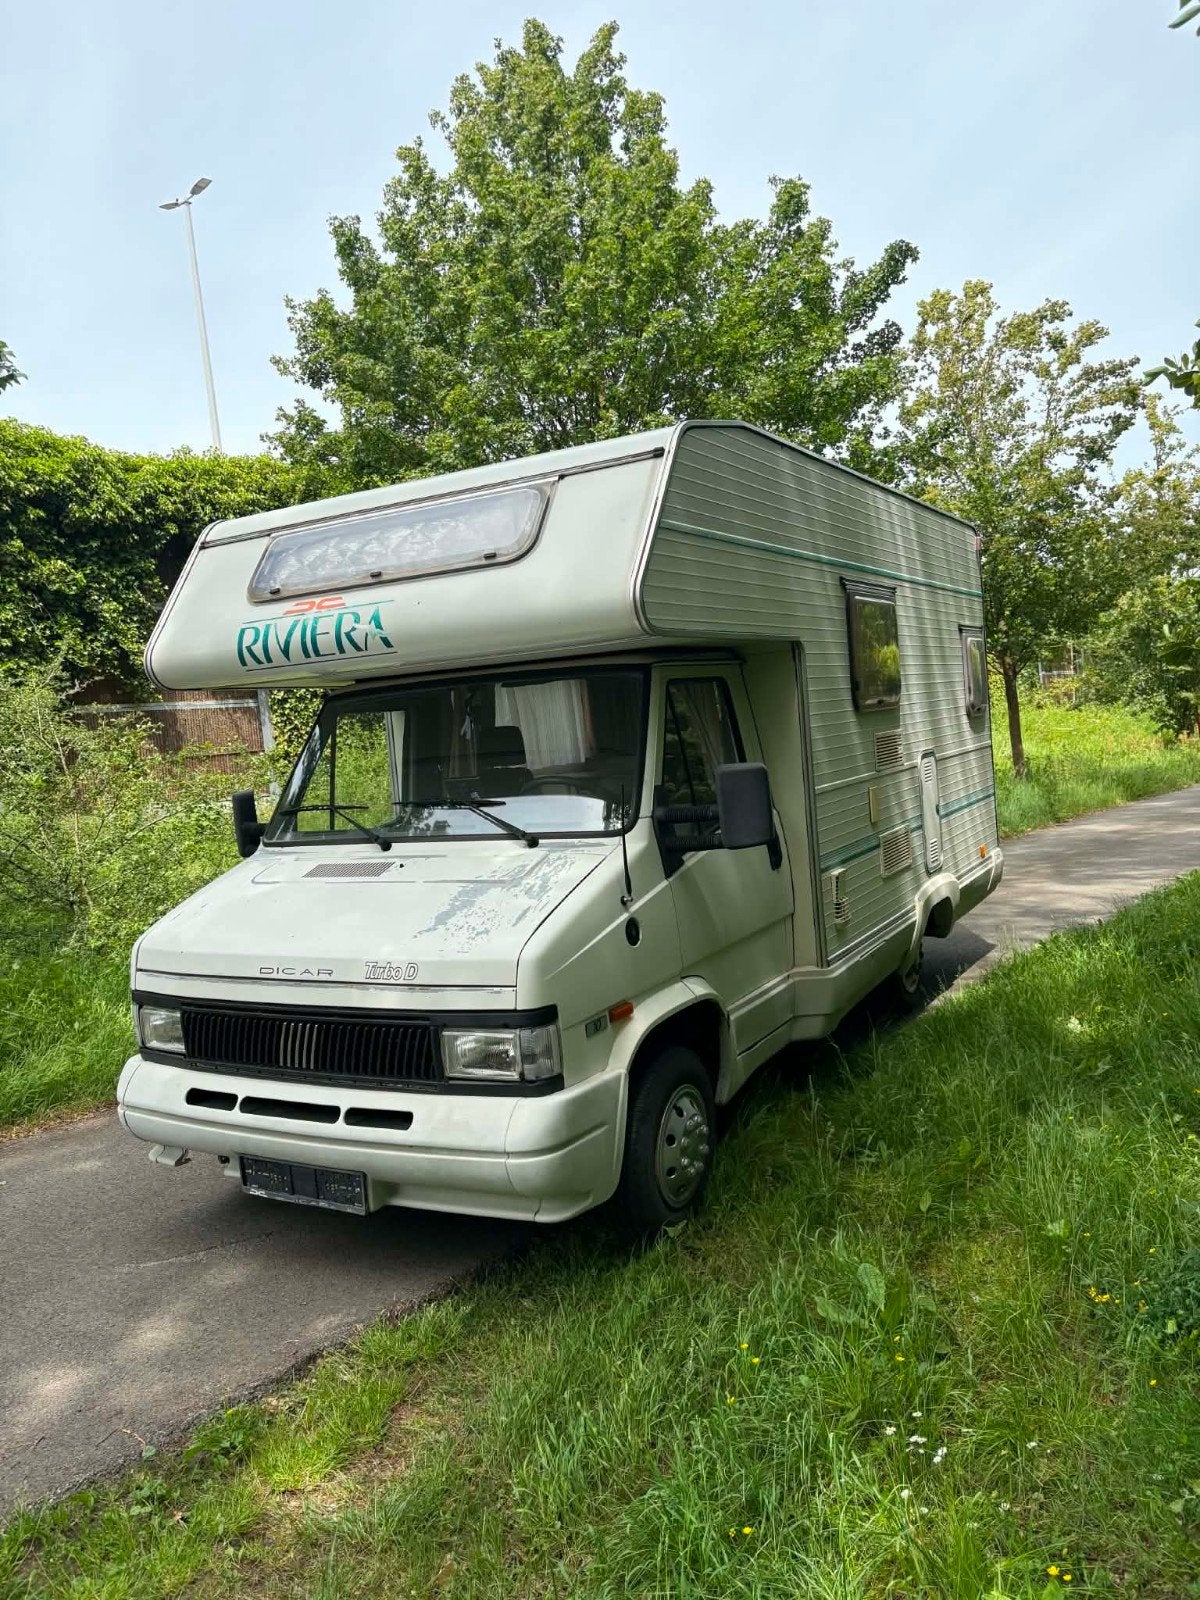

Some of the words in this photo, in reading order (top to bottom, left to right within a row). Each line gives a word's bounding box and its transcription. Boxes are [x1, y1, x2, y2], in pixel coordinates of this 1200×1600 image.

[237, 606, 394, 667] RIVIERA
[259, 966, 334, 977] DICAR
[364, 961, 403, 980] Turbo
[403, 963, 419, 981] D
